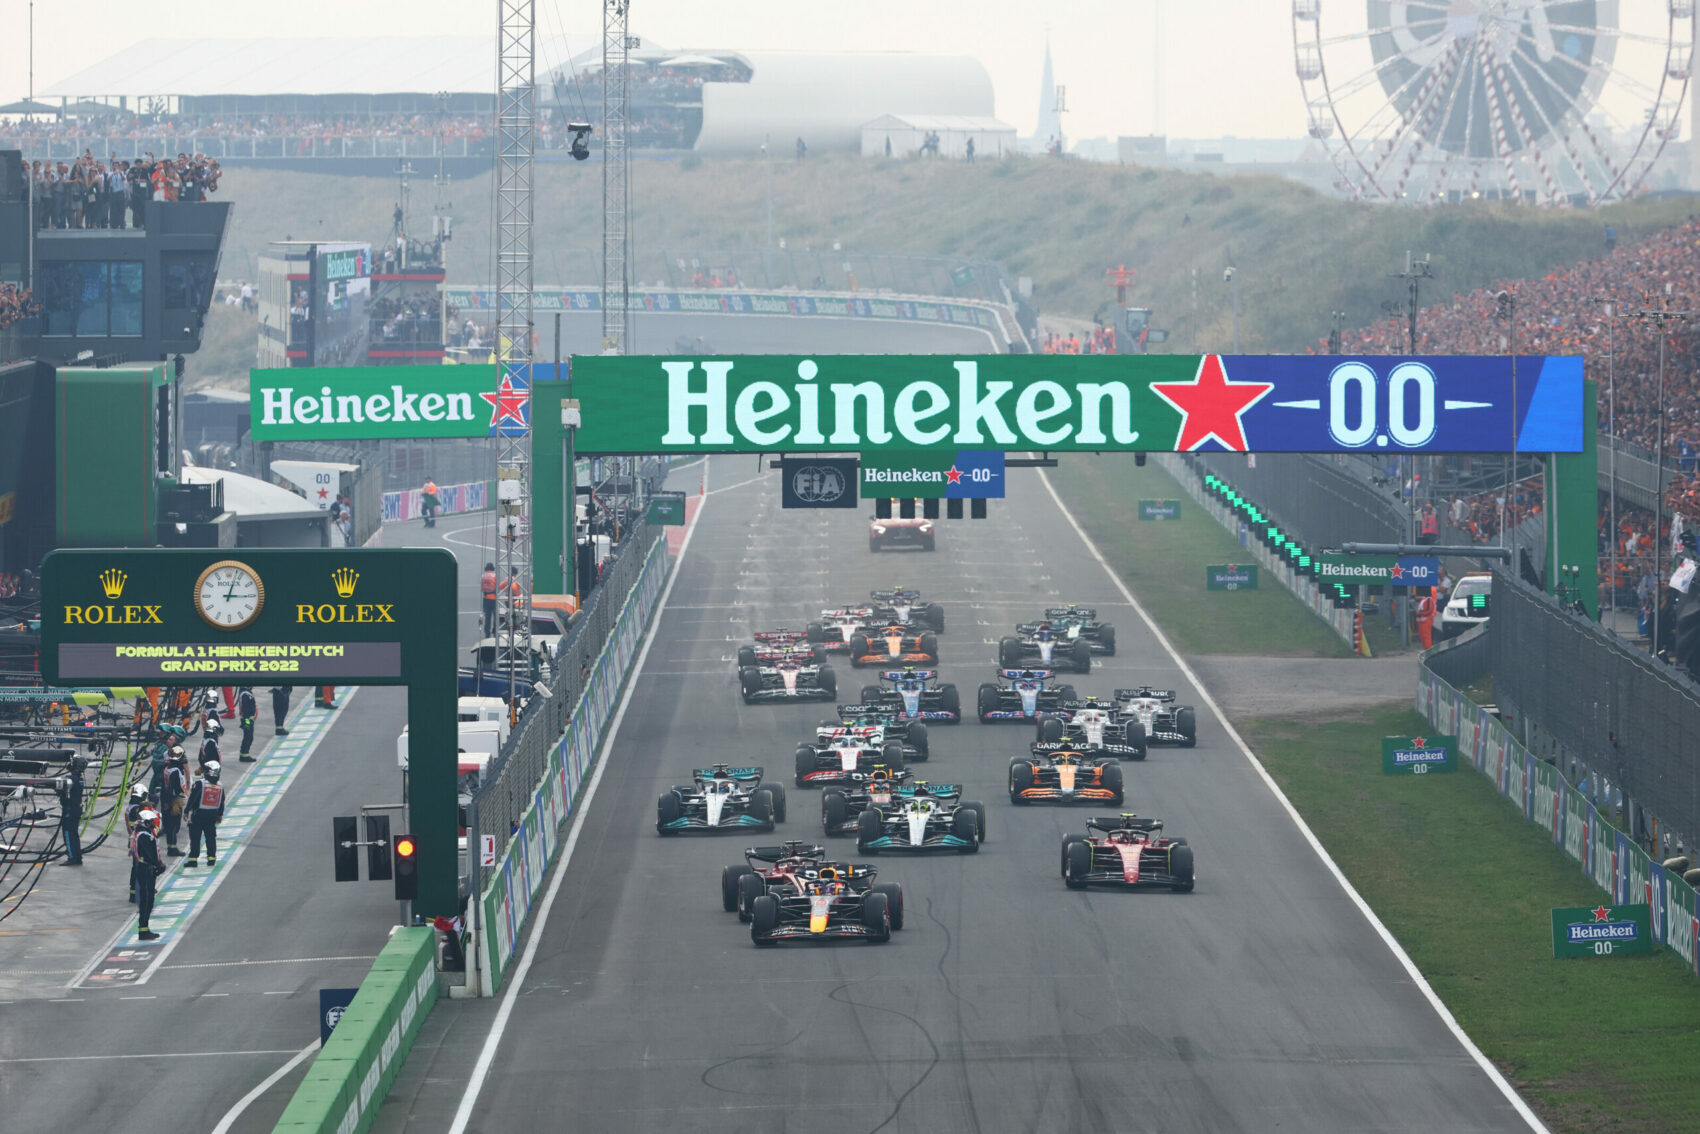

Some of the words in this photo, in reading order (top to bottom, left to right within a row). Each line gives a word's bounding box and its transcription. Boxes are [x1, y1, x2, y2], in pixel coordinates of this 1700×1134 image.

[327, 252, 355, 279] Heineken
[260, 385, 475, 425] Heineken
[661, 359, 1139, 446] Heineken
[1329, 361, 1436, 447] 0.0
[864, 467, 943, 482] Heineken
[971, 468, 990, 482] 0.0
[1322, 563, 1387, 577] Heineken
[63, 605, 163, 624] ROLEX
[296, 604, 396, 623] ROLEX
[115, 646, 194, 657] FORMULA
[197, 646, 207, 657] 1
[208, 646, 290, 657] HEINEKEN
[291, 645, 344, 657] DUTCH
[160, 660, 217, 672] GRAND
[219, 660, 256, 672] PRIX
[259, 660, 299, 672] 2022
[1036, 742, 1091, 750] DARKRACE
[1395, 750, 1445, 762] Heineken
[702, 768, 755, 776] PEONAS
[899, 784, 953, 793] PEONAS
[1571, 925, 1634, 939] Heineken
